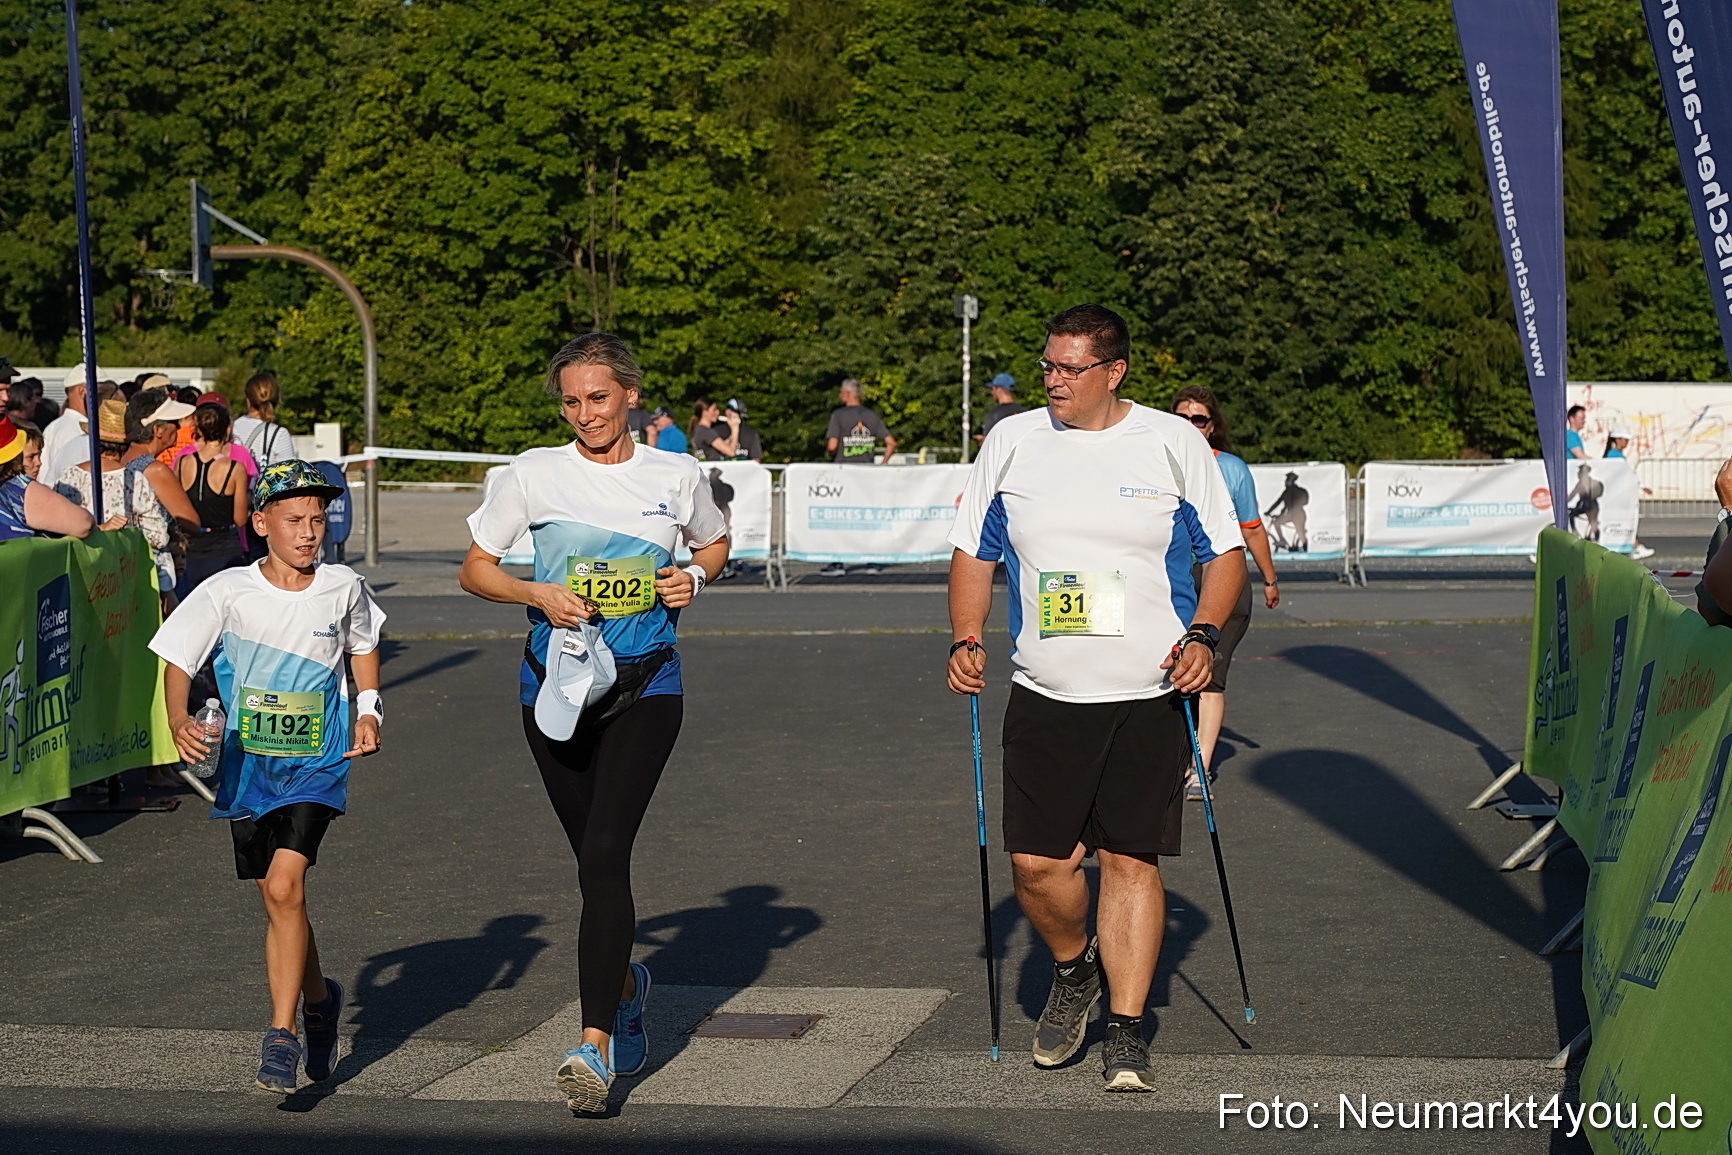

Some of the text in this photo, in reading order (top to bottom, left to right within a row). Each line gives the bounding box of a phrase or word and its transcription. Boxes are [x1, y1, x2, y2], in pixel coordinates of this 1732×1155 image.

[809, 485, 844, 498] NOW
[1135, 488, 1159, 496] PETTER
[1388, 485, 1423, 498] NOW
[811, 508, 861, 520] E-BIKES
[864, 508, 874, 520] &
[1440, 506, 1451, 518] &
[582, 578, 642, 599] 1202
[643, 580, 652, 607] 2022
[621, 599, 641, 608] Yulia
[1043, 596, 1051, 627] WALK
[41, 608, 69, 634] Fischer
[1054, 615, 1087, 625] Hornung
[242, 716, 250, 739] RUN
[252, 711, 311, 736] 1192
[311, 717, 321, 747] 2022
[250, 733, 309, 745] Miskinis Nikita
